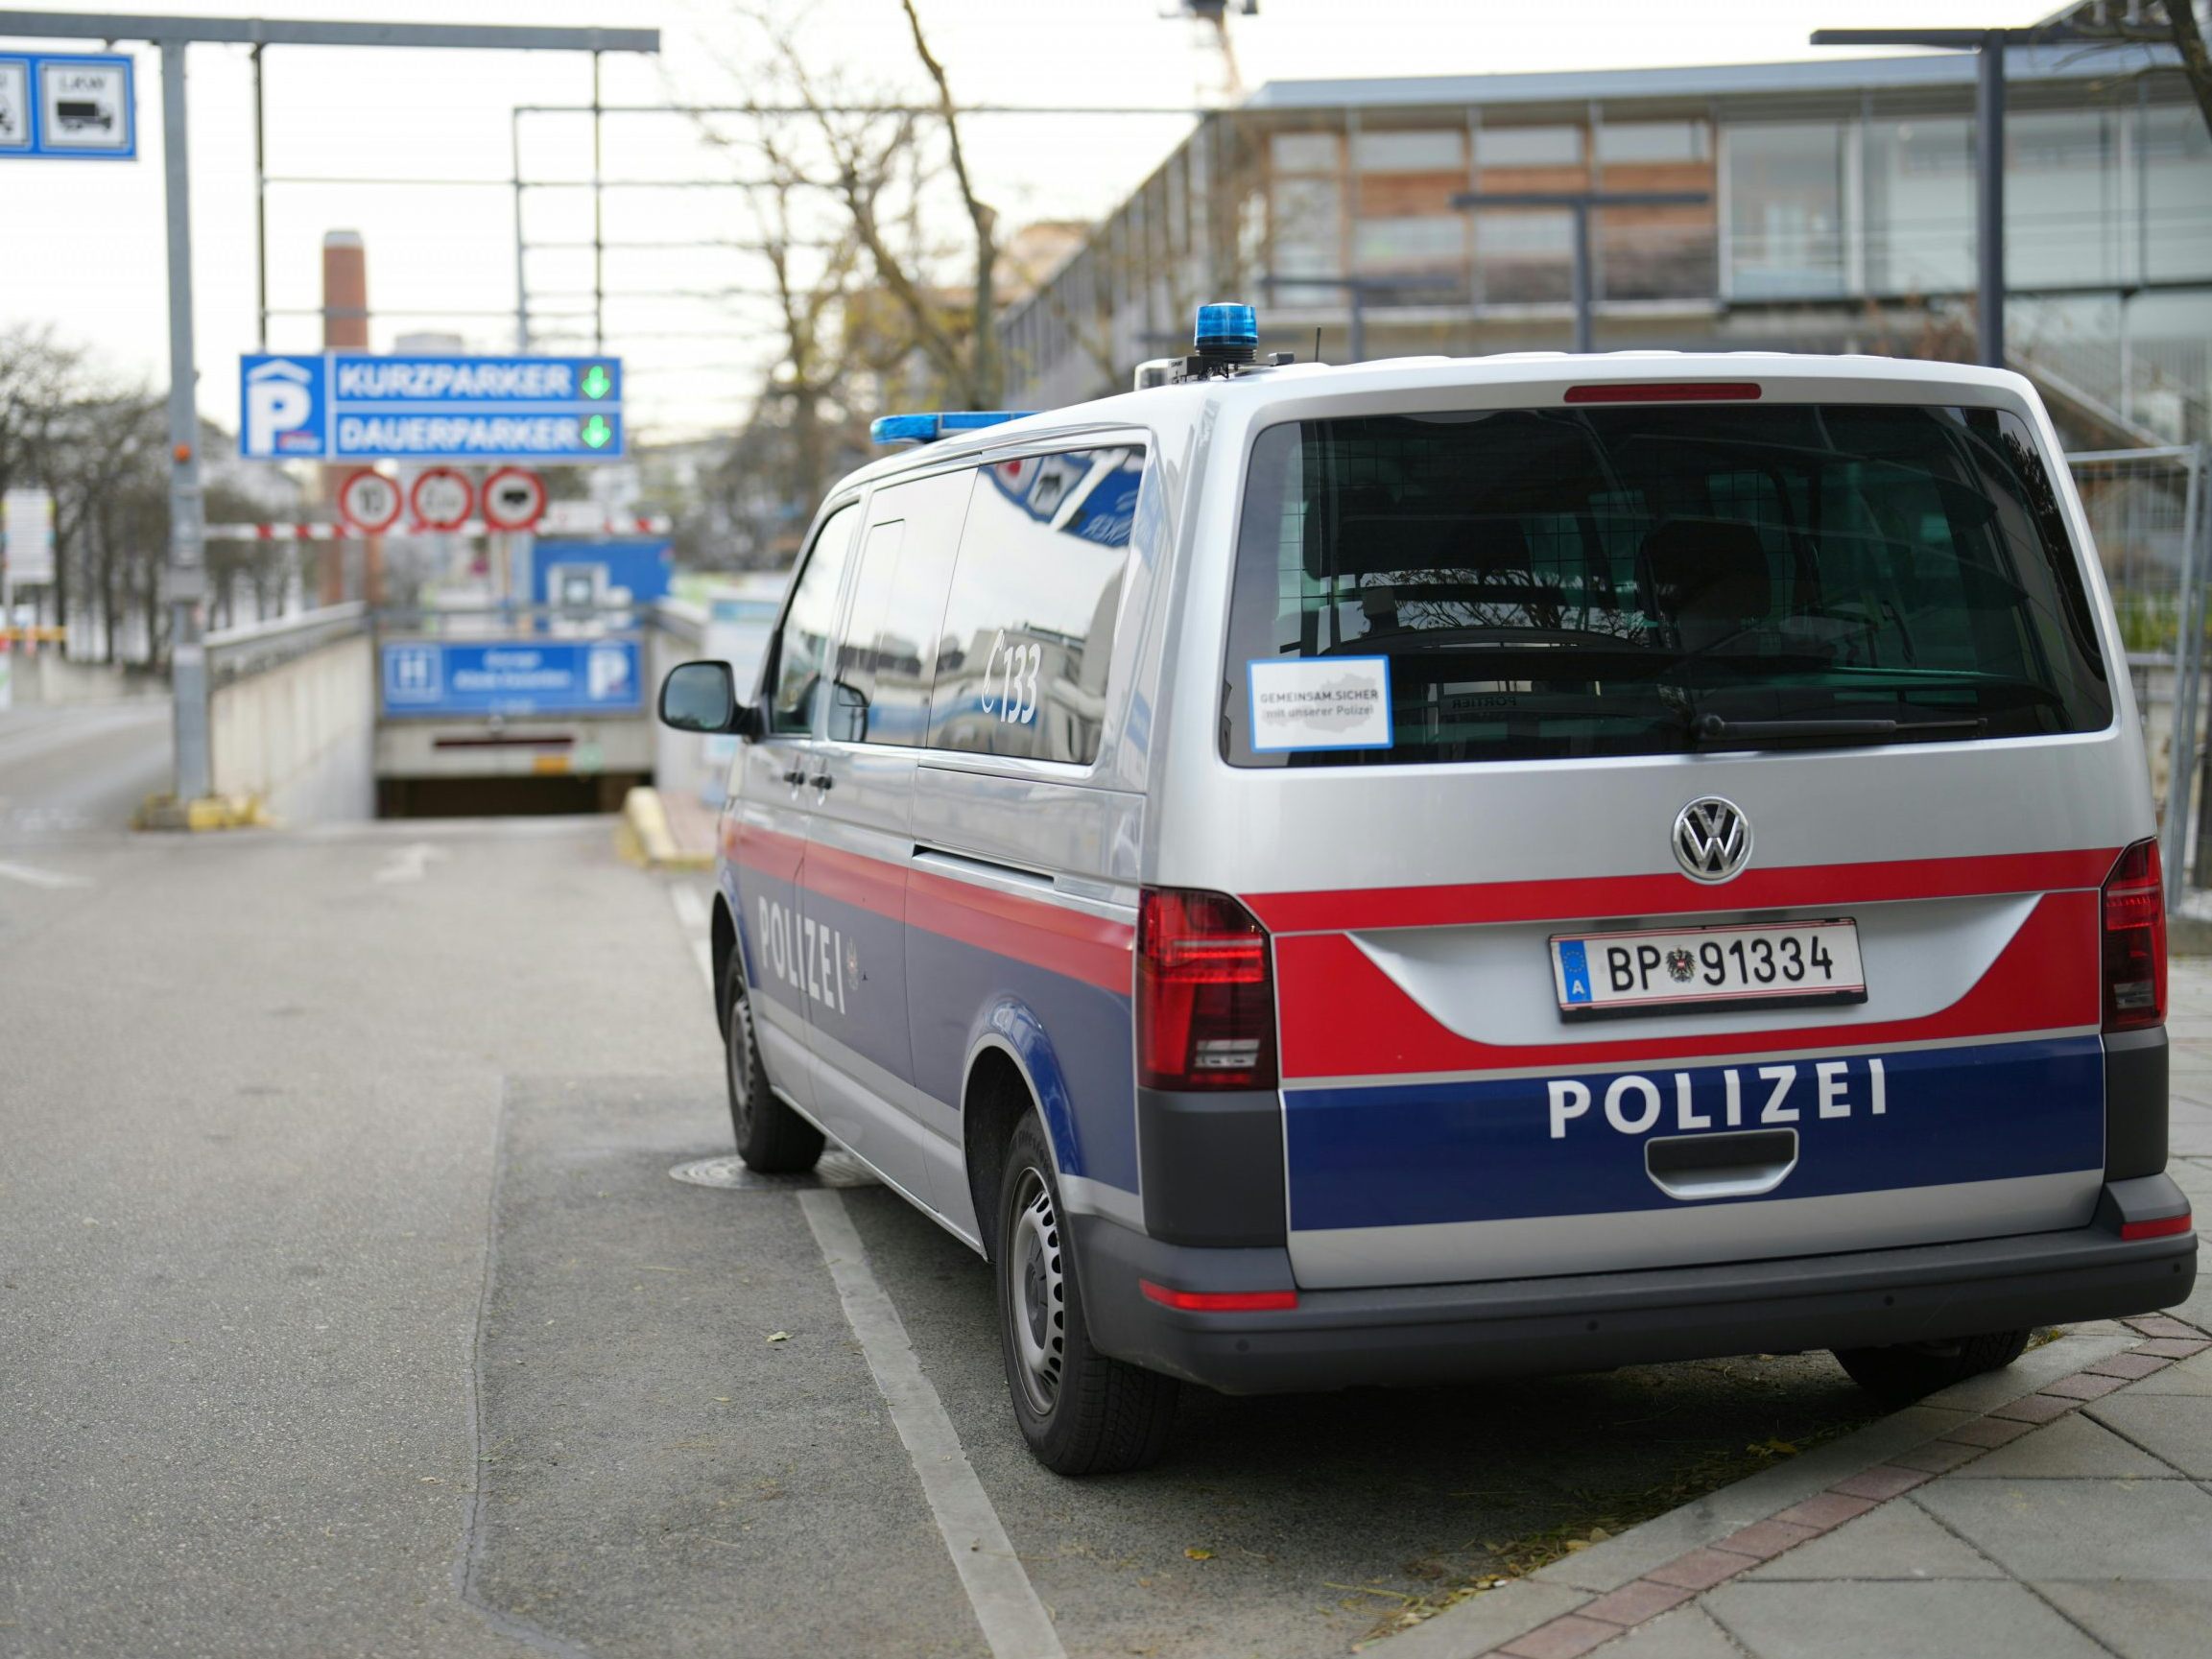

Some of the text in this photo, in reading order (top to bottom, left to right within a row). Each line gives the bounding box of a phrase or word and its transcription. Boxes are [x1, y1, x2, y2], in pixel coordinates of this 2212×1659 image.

[338, 363, 572, 398] KURZPARKER
[248, 381, 312, 456] P
[338, 416, 580, 451] DAUERPARKER
[1001, 643, 1041, 724] 133
[1288, 704, 1333, 717] unserer
[758, 895, 845, 1015] POLIZEI
[1606, 936, 1833, 992] BP 91334
[1571, 980, 1585, 995] A
[1547, 1058, 1887, 1139] POLIZEI
